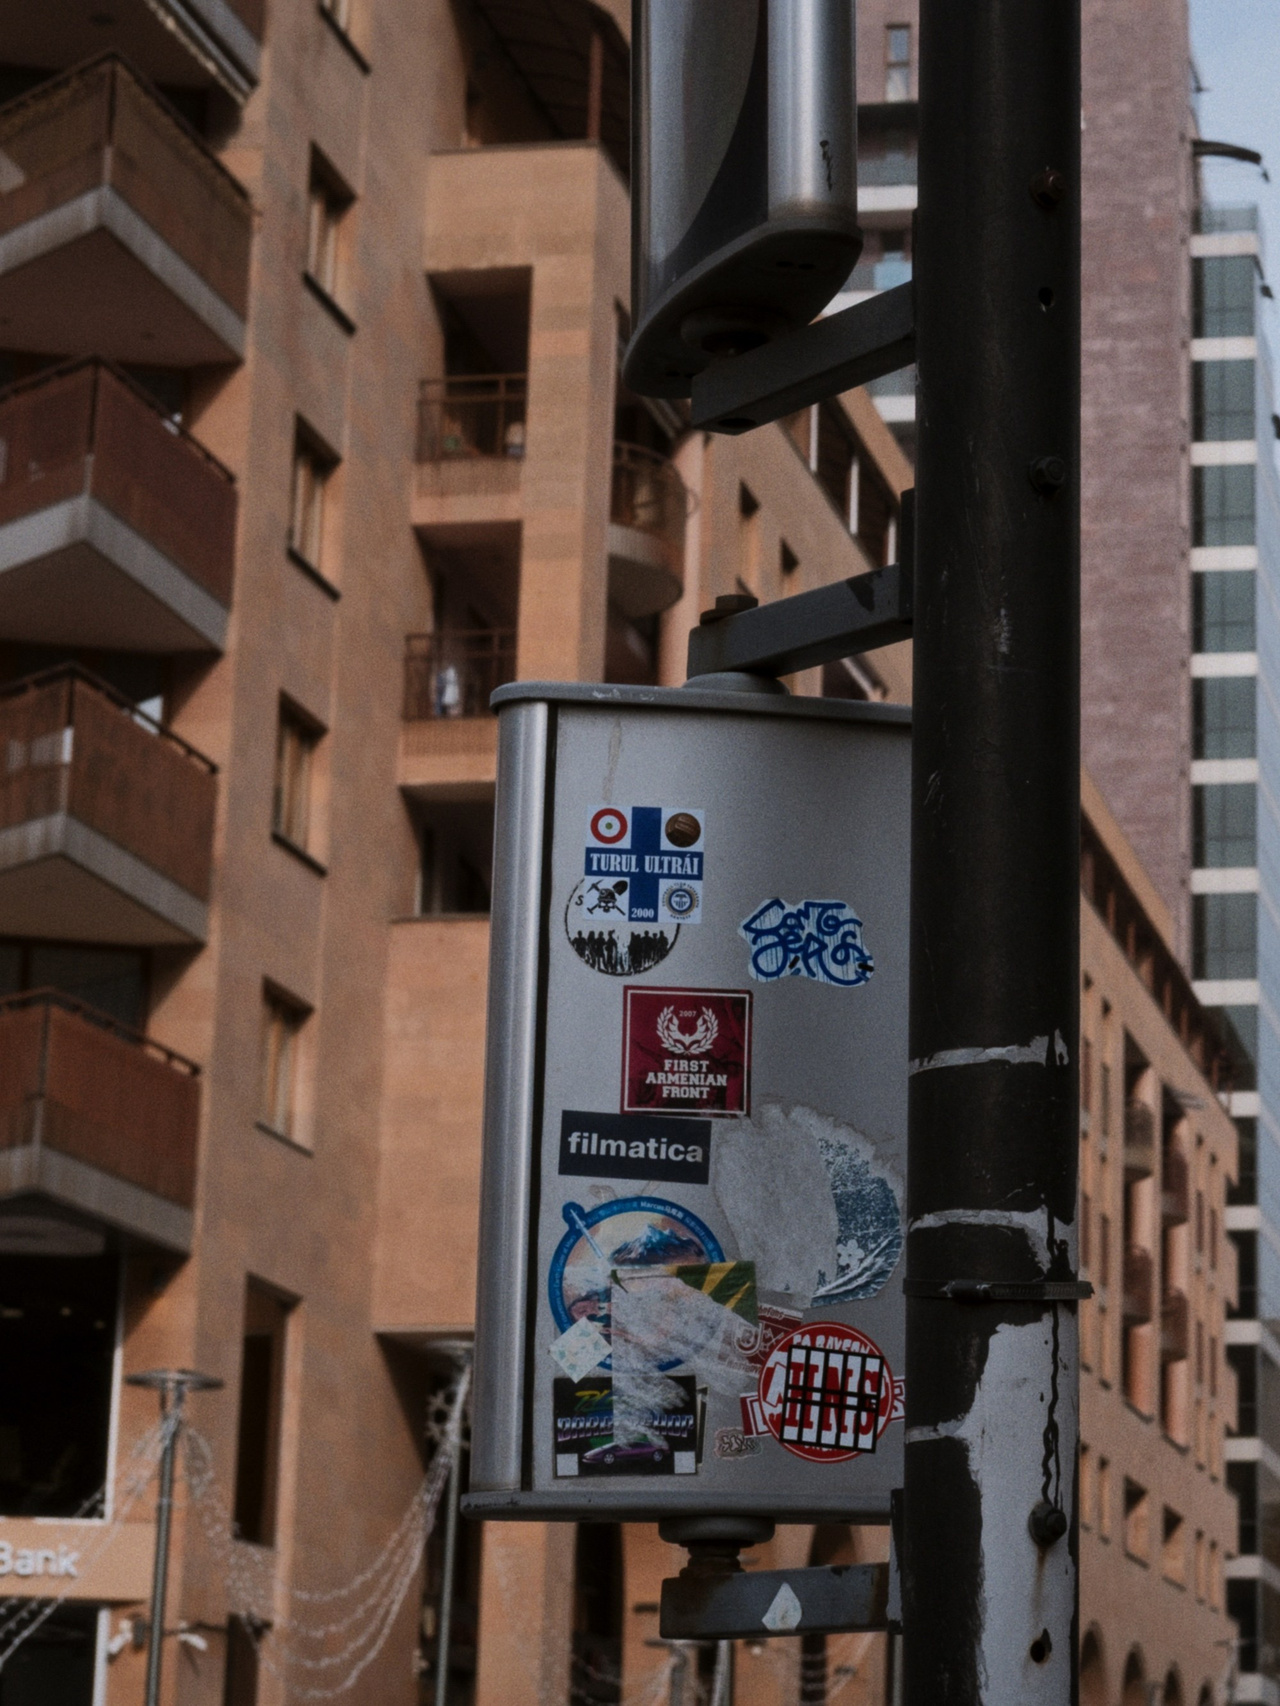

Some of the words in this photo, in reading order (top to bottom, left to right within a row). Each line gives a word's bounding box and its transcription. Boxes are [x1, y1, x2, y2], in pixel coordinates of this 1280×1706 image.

[590, 853, 639, 873] TURUL
[644, 853, 700, 876] ULTRÁI
[631, 908, 654, 919] 2000
[679, 1010, 697, 1018] 2007
[664, 1059, 709, 1073] FIRST
[645, 1072, 728, 1087] ARMENIAN
[662, 1085, 710, 1100] FRONT
[567, 1131, 704, 1163] filmatica
[0, 1540, 79, 1576] Bank
